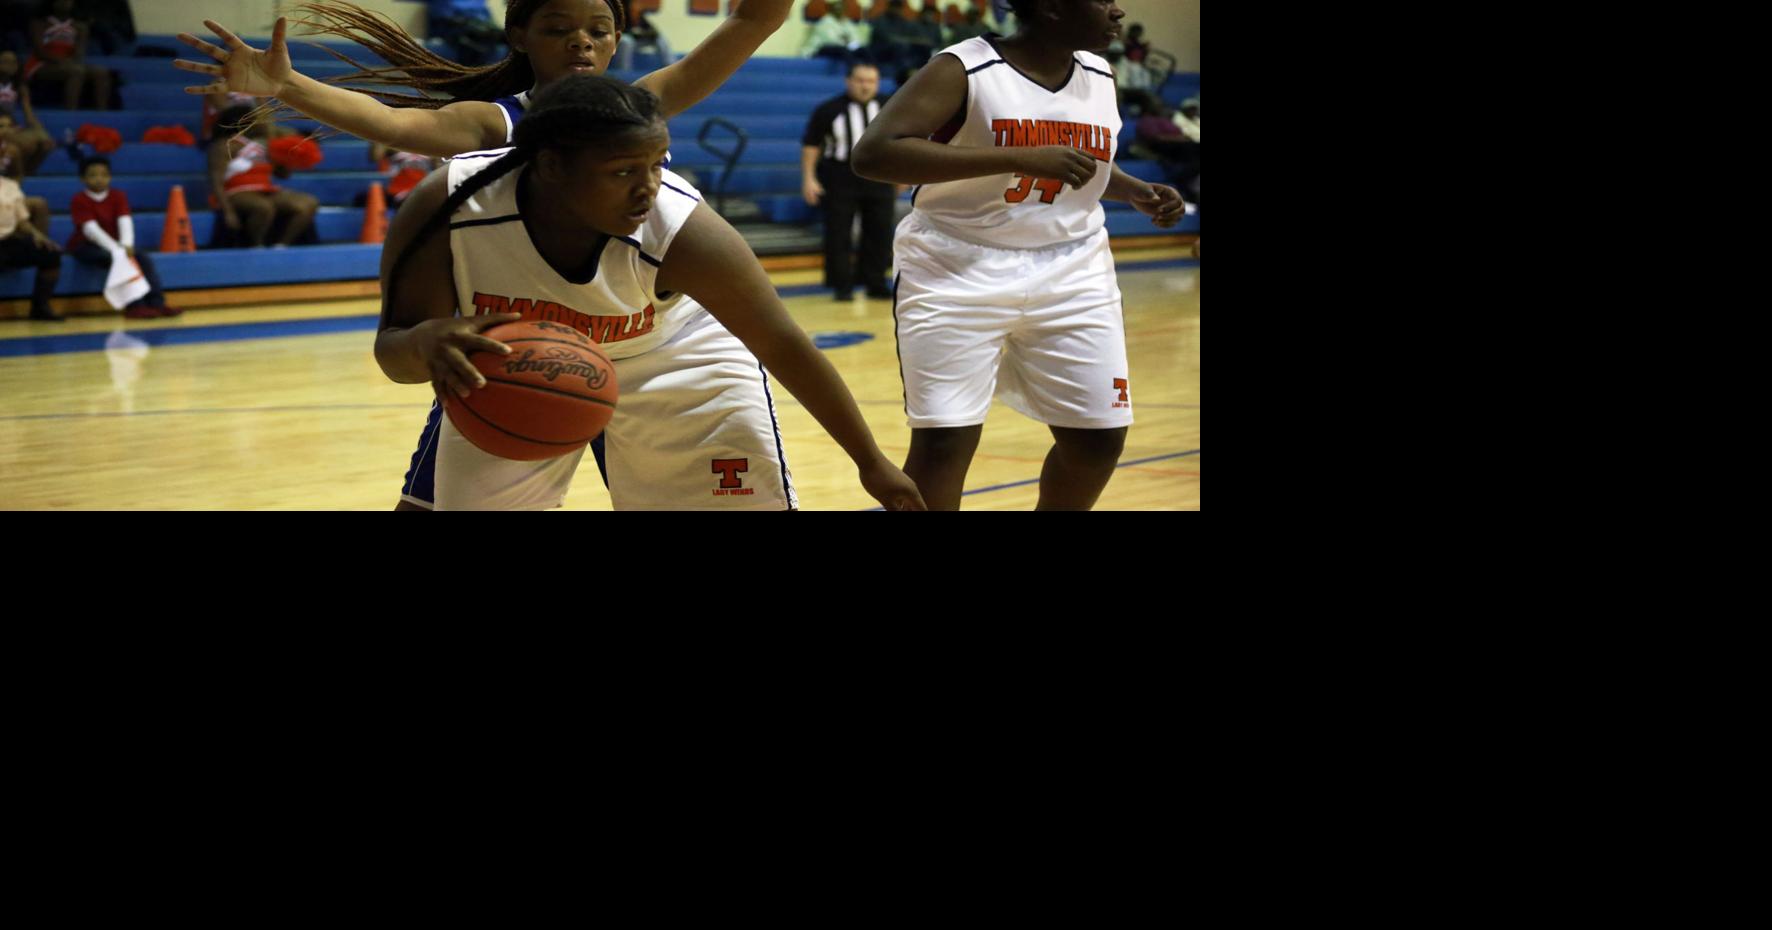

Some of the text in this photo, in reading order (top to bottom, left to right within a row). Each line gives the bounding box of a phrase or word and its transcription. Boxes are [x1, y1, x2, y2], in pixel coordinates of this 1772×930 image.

[992, 118, 1111, 163] TIMMONSVILLE
[472, 291, 656, 344] TIMMONSVILLE
[503, 350, 608, 390] Rawlings
[711, 458, 748, 488] T
